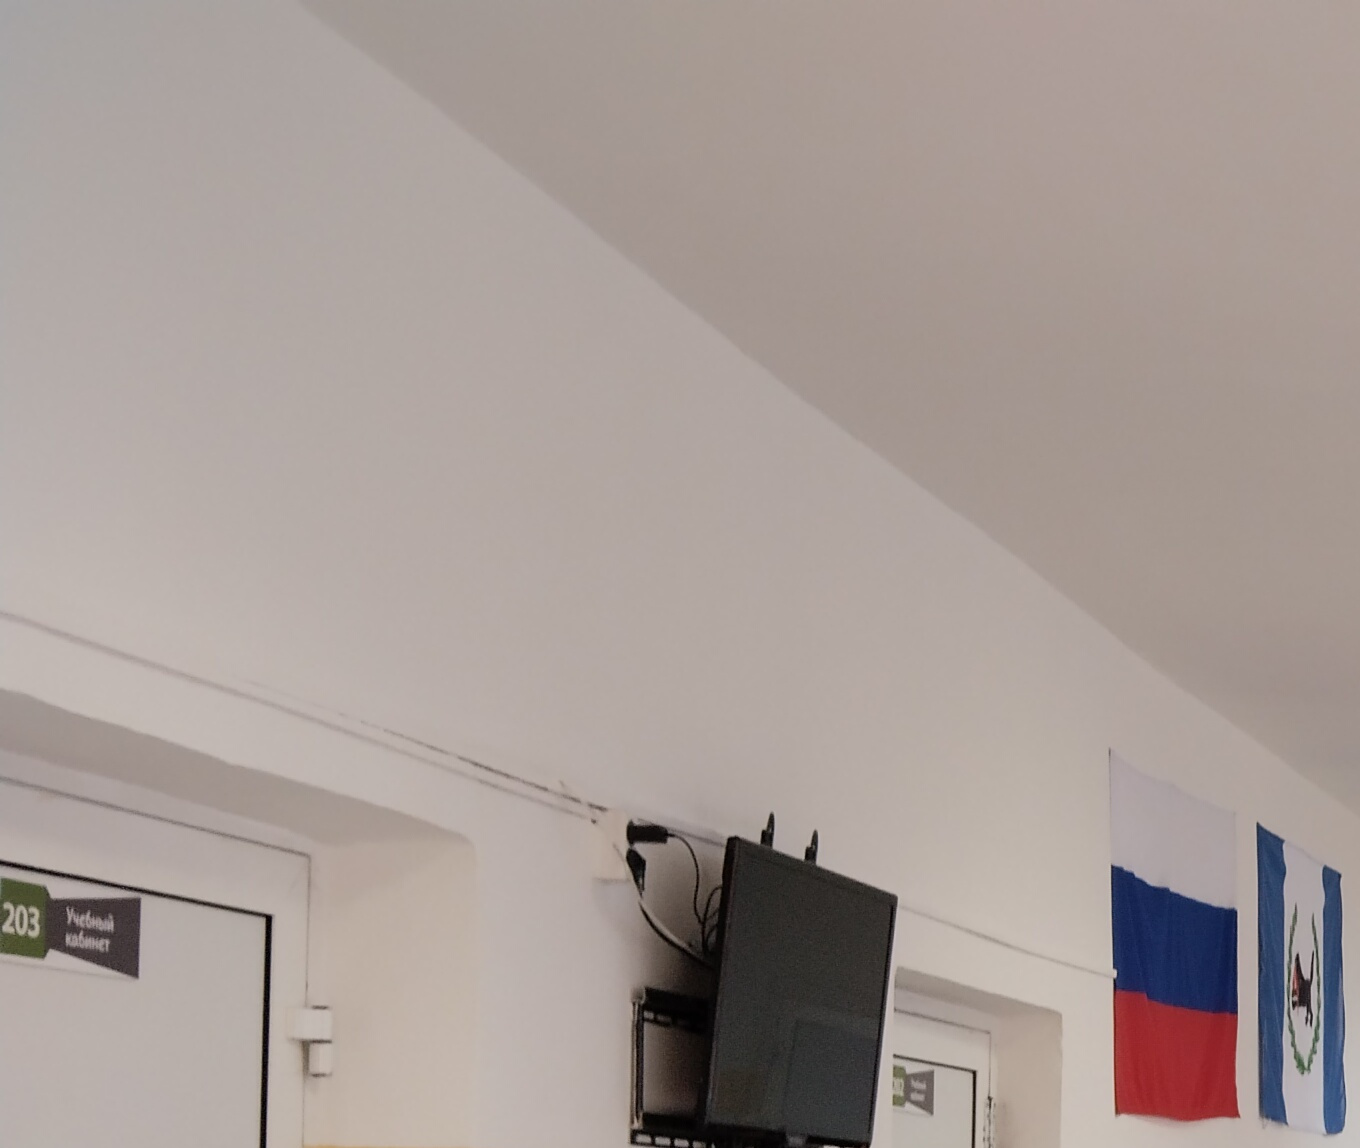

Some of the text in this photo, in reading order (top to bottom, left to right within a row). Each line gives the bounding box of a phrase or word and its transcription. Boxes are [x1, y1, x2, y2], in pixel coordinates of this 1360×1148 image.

[1, 901, 41, 938] 203
[65, 906, 115, 932] Учебный
[65, 931, 110, 952] кабинет
